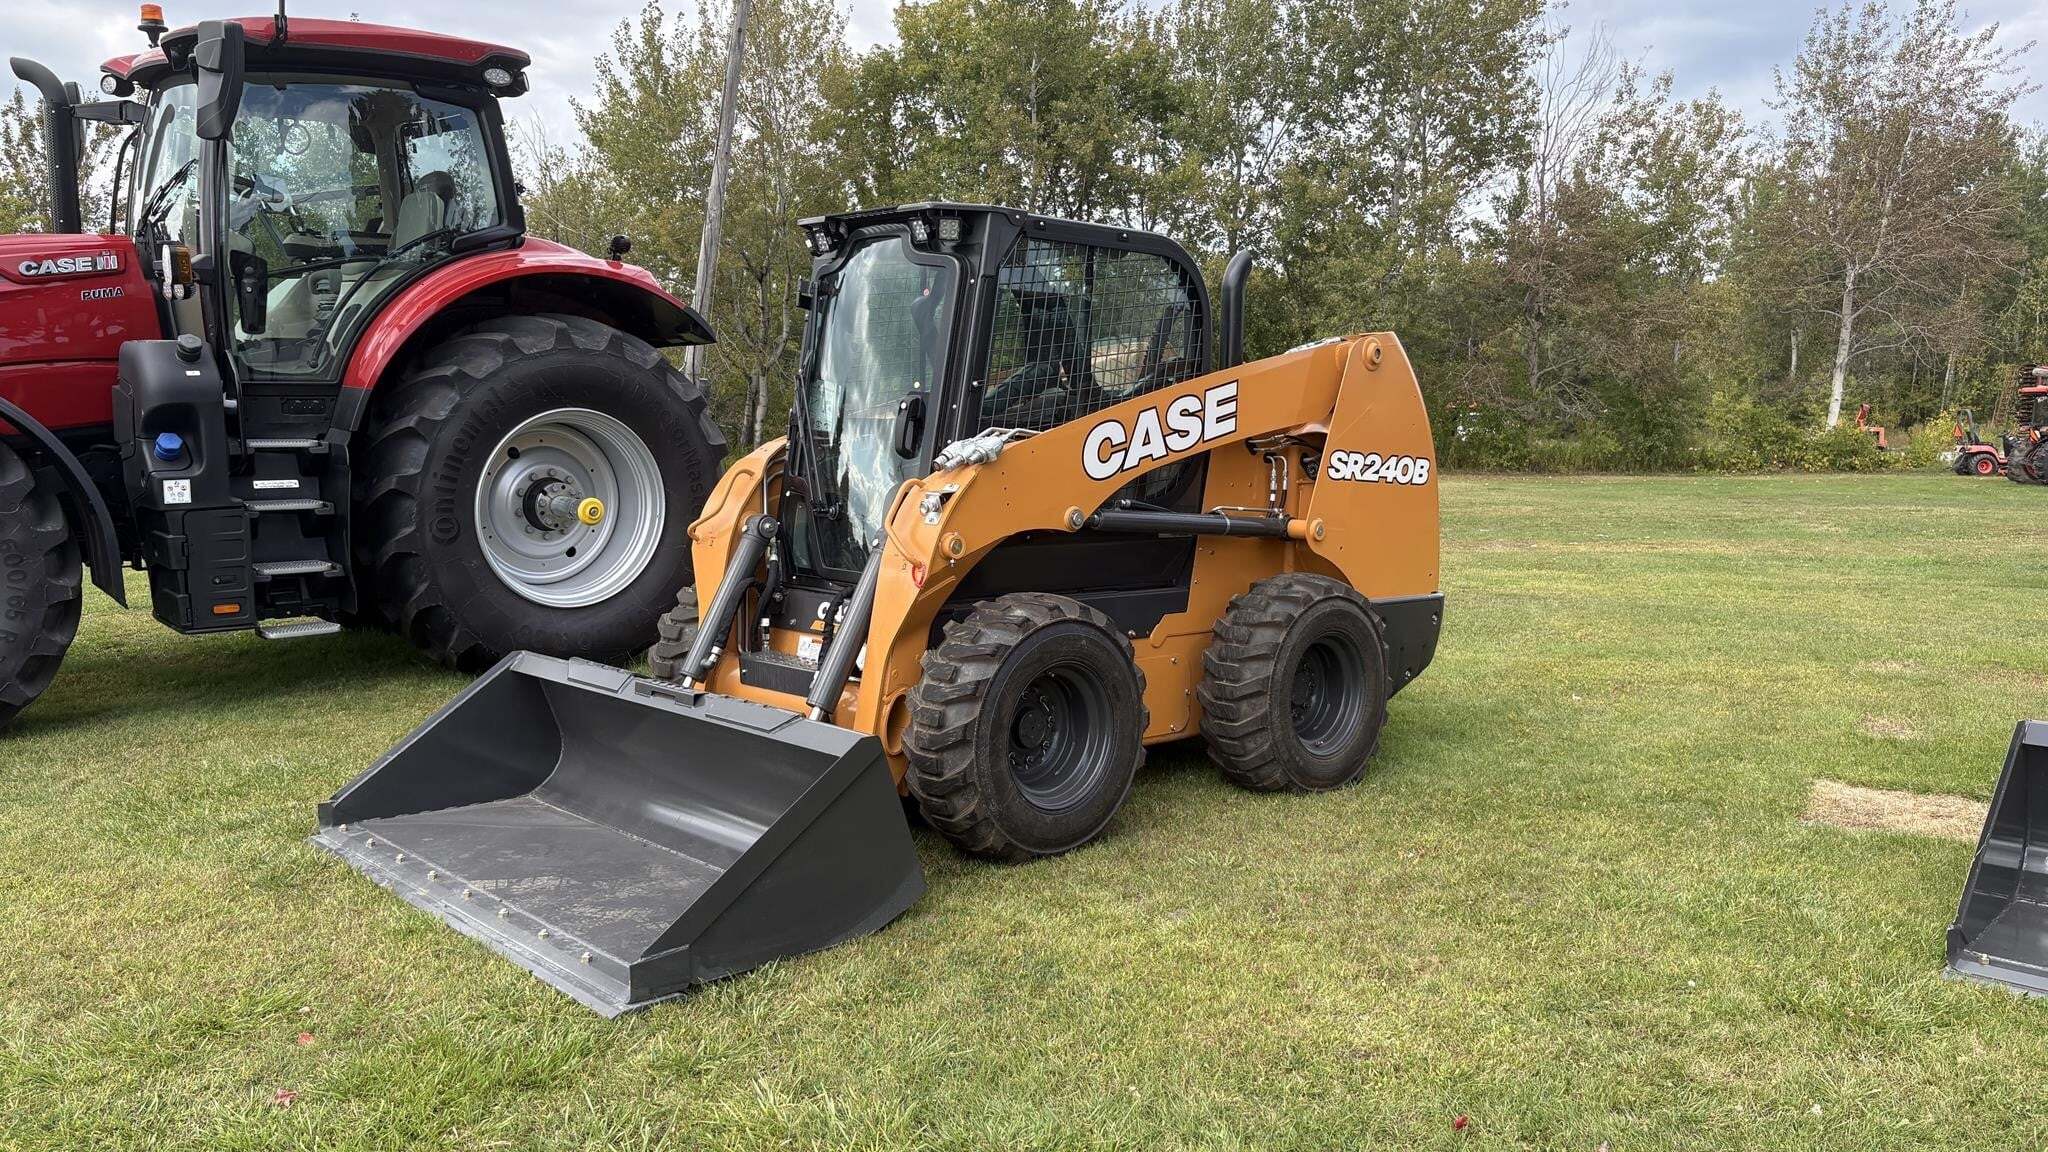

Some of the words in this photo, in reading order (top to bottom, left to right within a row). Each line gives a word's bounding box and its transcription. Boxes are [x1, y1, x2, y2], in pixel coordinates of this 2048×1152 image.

[18, 258, 92, 276] CASE
[81, 287, 125, 300] PUMA
[1082, 379, 1239, 481] CASE
[1327, 449, 1431, 485] SR240B
